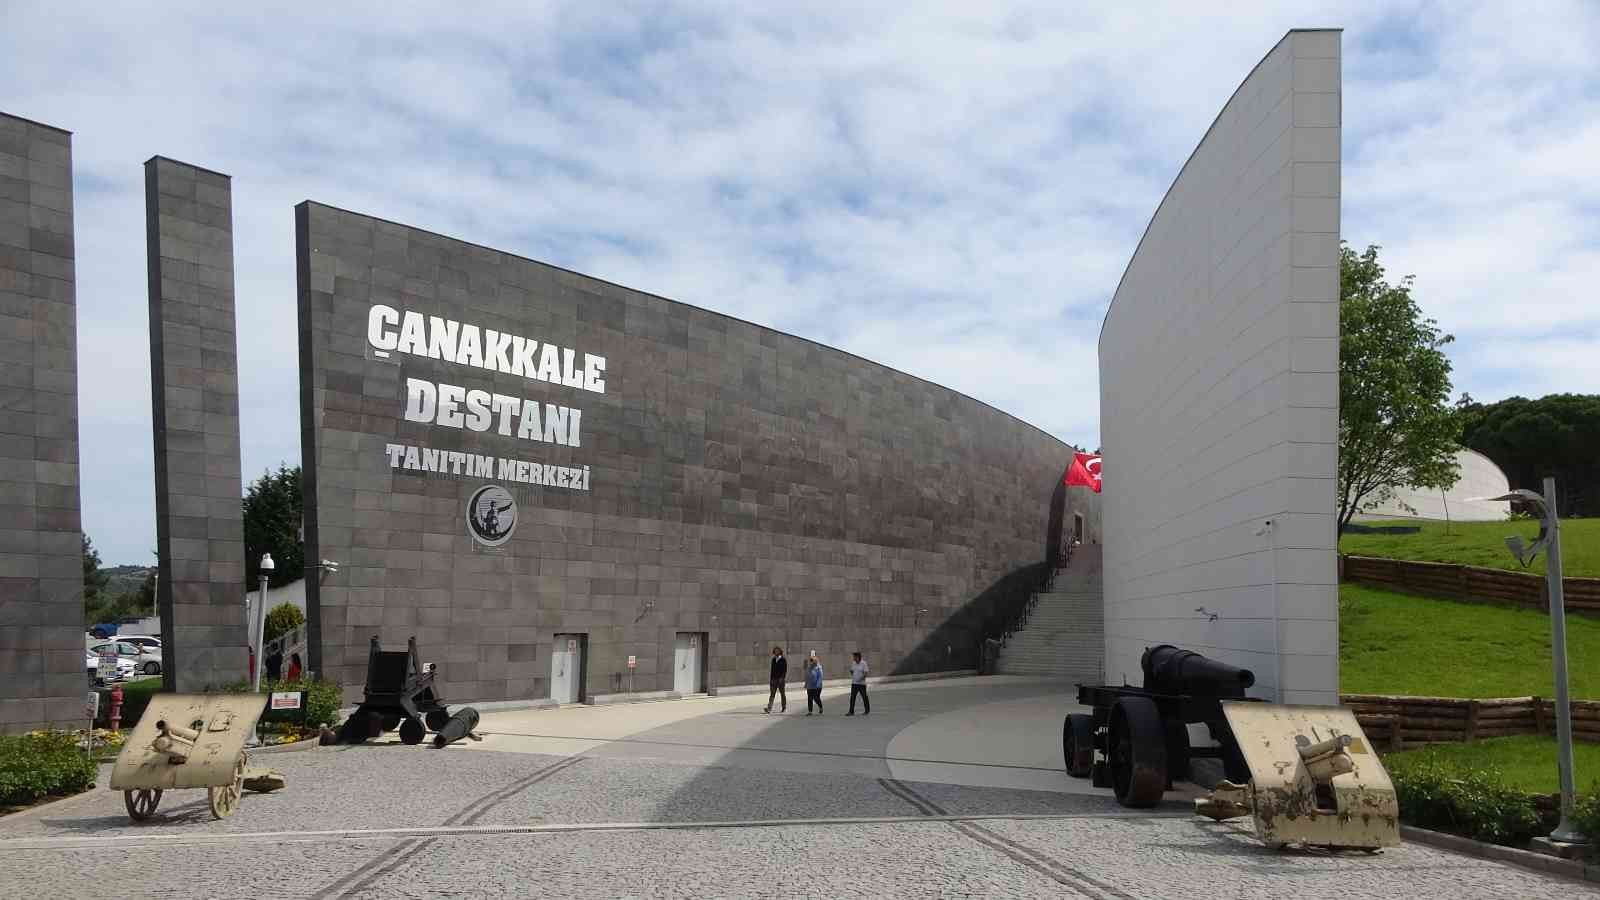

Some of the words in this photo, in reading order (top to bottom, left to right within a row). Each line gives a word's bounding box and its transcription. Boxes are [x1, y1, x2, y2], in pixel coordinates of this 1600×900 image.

[367, 304, 606, 393] ÇANAKKALE
[404, 377, 582, 448] DESTANI
[385, 443, 495, 479] TANITIM
[497, 458, 592, 490] MERKEZİ
